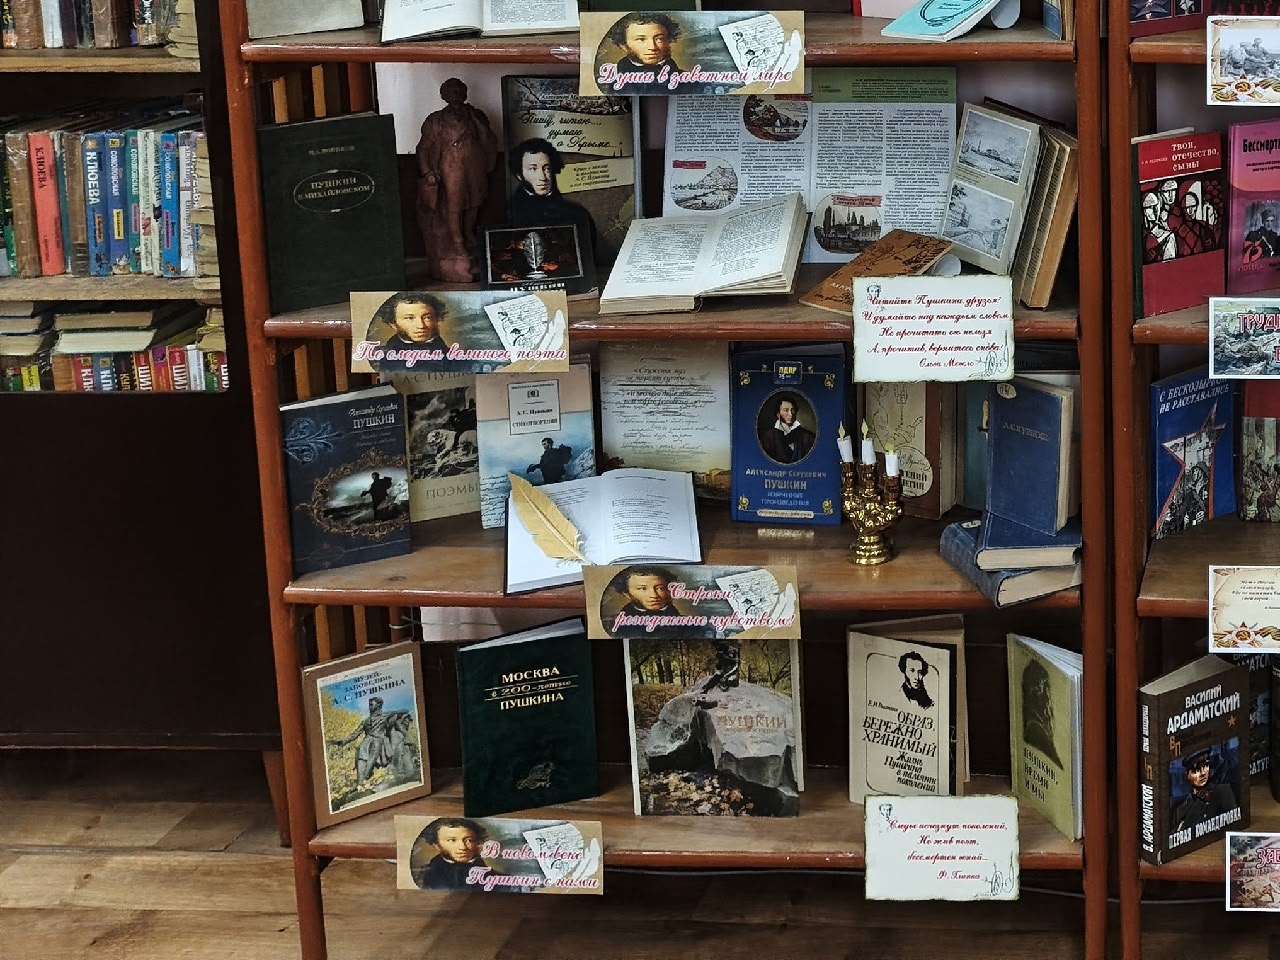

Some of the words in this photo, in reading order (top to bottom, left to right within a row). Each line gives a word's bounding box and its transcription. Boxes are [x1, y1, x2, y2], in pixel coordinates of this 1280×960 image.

[599, 63, 655, 89] Душа
[669, 66, 749, 89] заветной
[86, 151, 101, 206] КЛЮЕВА
[353, 413, 395, 429] ПУШКИН
[764, 479, 807, 491] ПУШКИН
[502, 666, 560, 684] МОСКВА
[500, 692, 564, 710] ПУШКИНА
[1185, 684, 1222, 709] ВАСИЛИЙ
[898, 711, 935, 731] ОБРАЗ,
[1167, 692, 1241, 735] АРДАМАТСКИЙ
[863, 716, 922, 740] БЕРЕЖНО
[862, 729, 937, 757] ХРАНИМЫЙ
[1168, 829, 1192, 850] ПЕРВАЯ
[1195, 807, 1242, 839] КОМАНДИРОВКА
